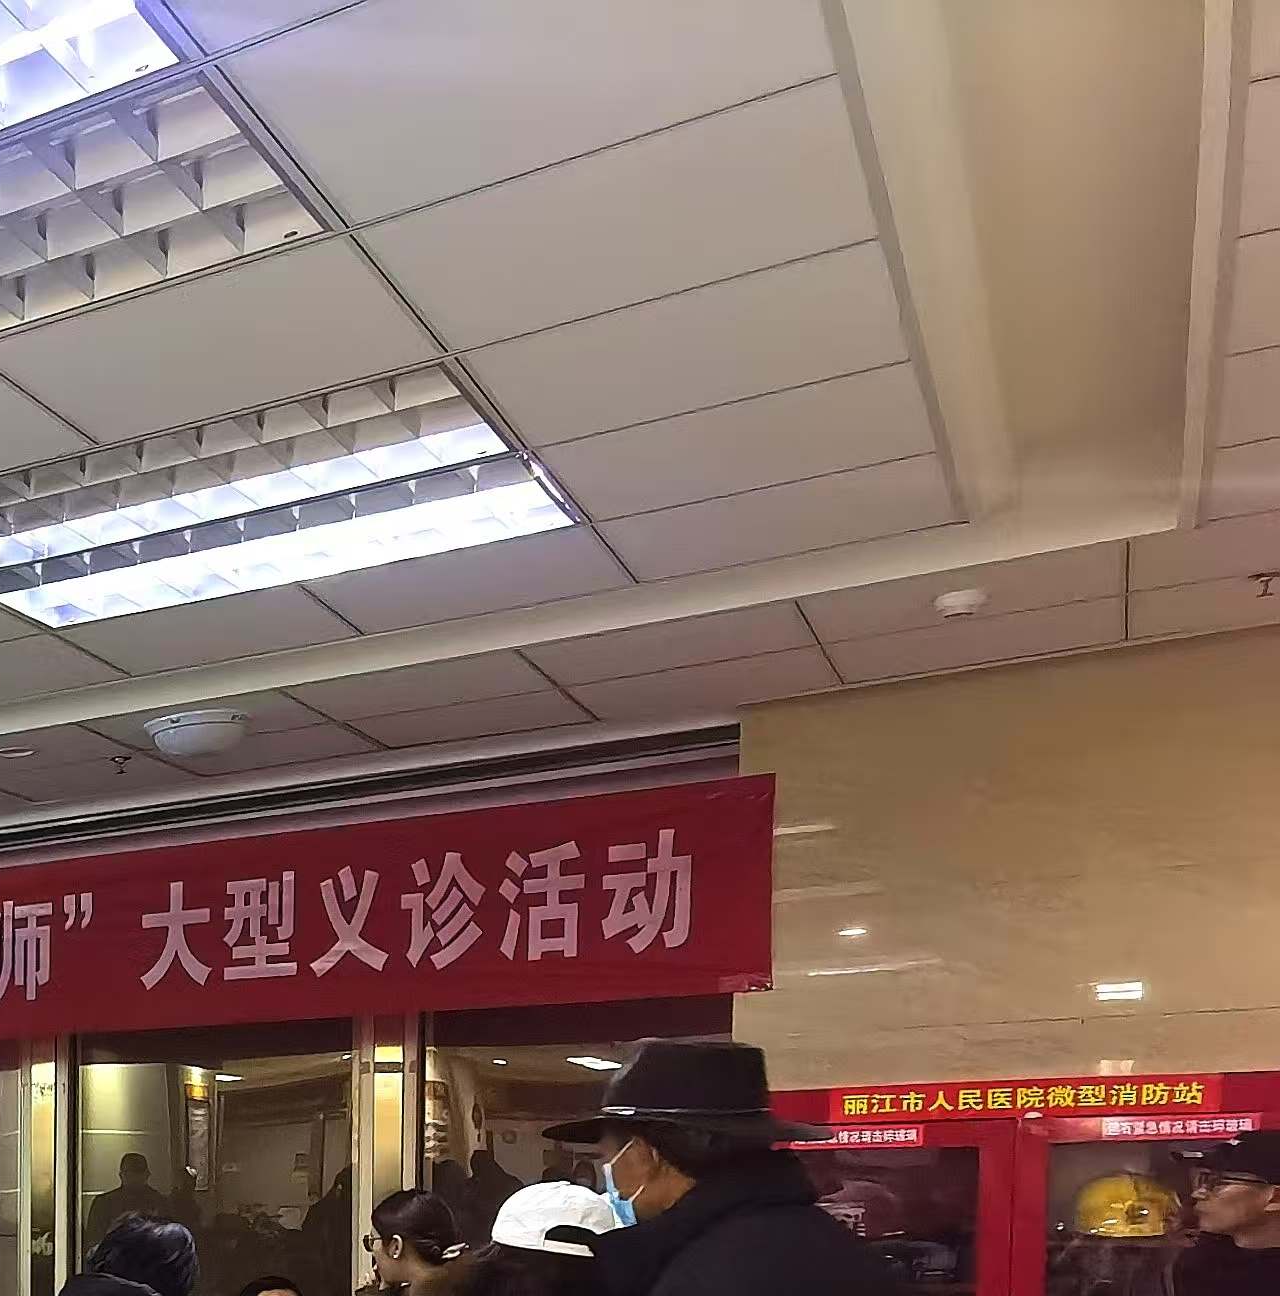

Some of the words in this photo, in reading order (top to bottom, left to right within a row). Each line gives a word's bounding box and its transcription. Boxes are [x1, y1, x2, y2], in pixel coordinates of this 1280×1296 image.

[140, 828, 693, 991] 大型义诊活动
[842, 1079, 1205, 1116] 丽江市人民医院微型消防站
